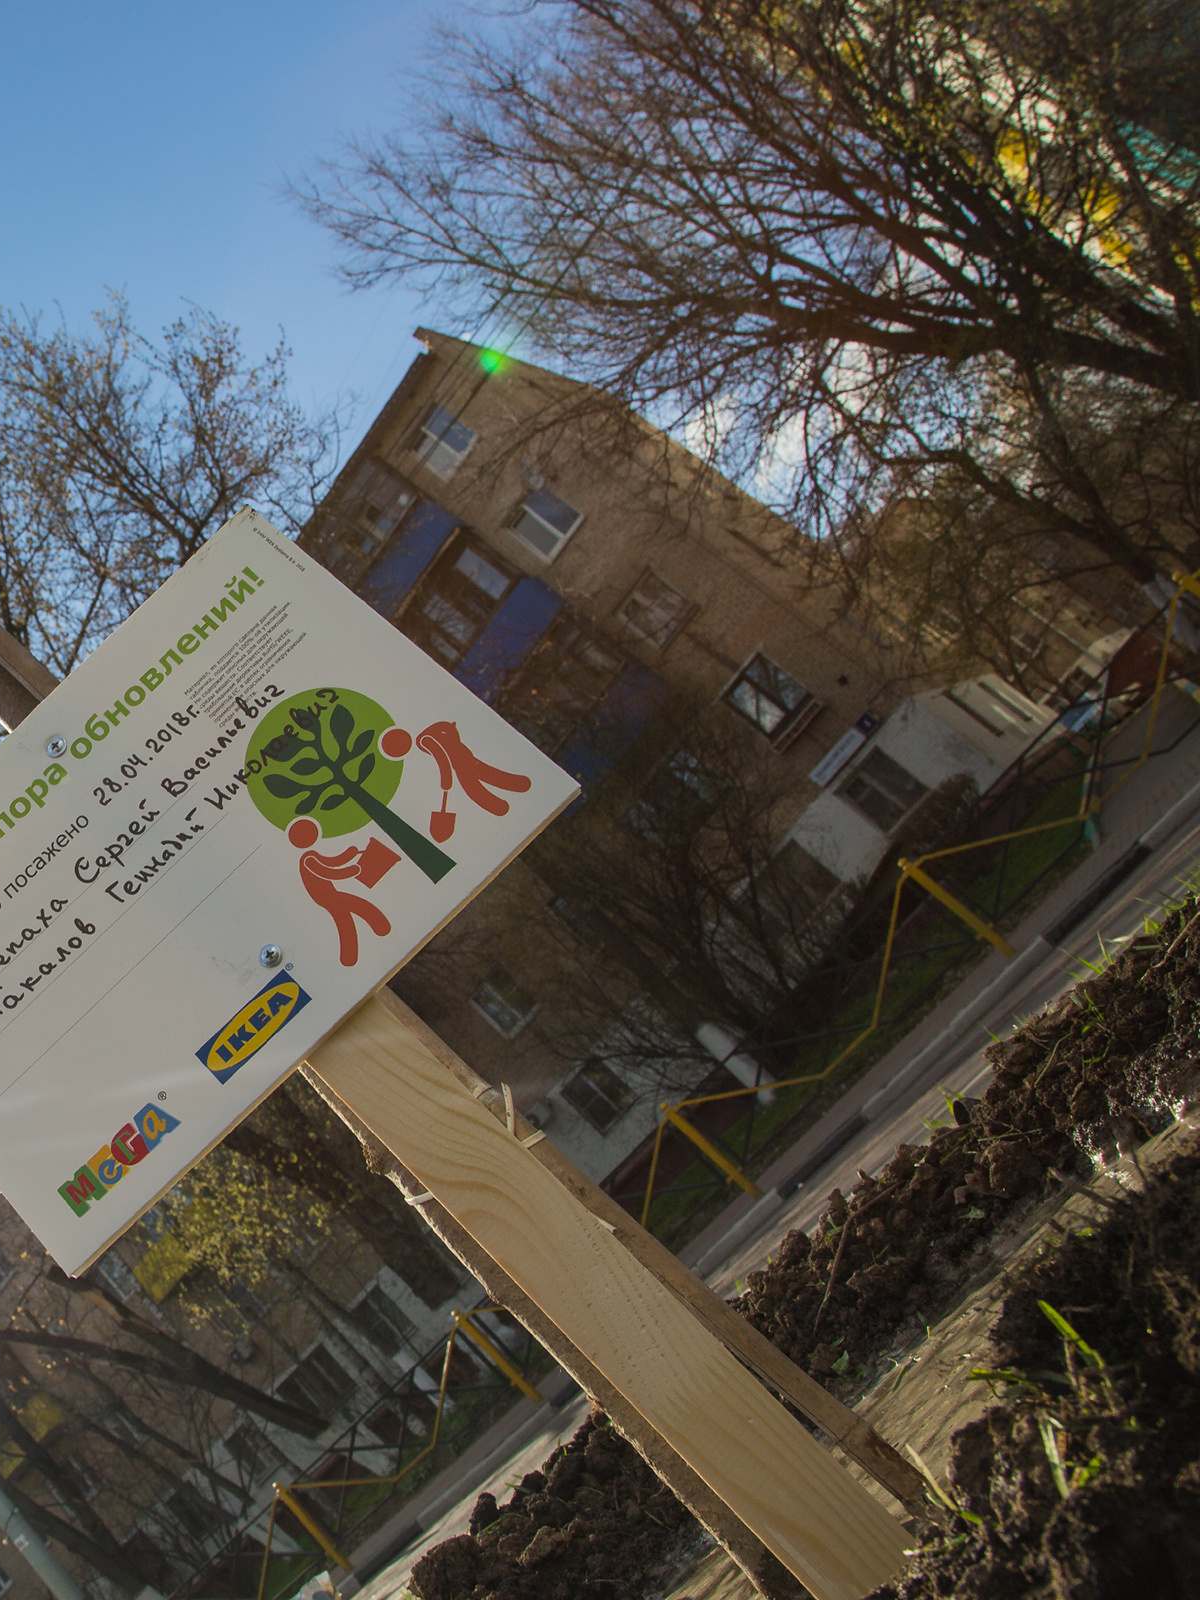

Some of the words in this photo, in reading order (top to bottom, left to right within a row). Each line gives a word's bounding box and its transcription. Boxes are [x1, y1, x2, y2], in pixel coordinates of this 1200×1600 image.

[265, 537, 275, 547] IKEA
[70, 566, 265, 759] обновлений!
[213, 693, 245, 724] применея
[2, 814, 90, 900] посажено
[74, 798, 161, 884] Сергей
